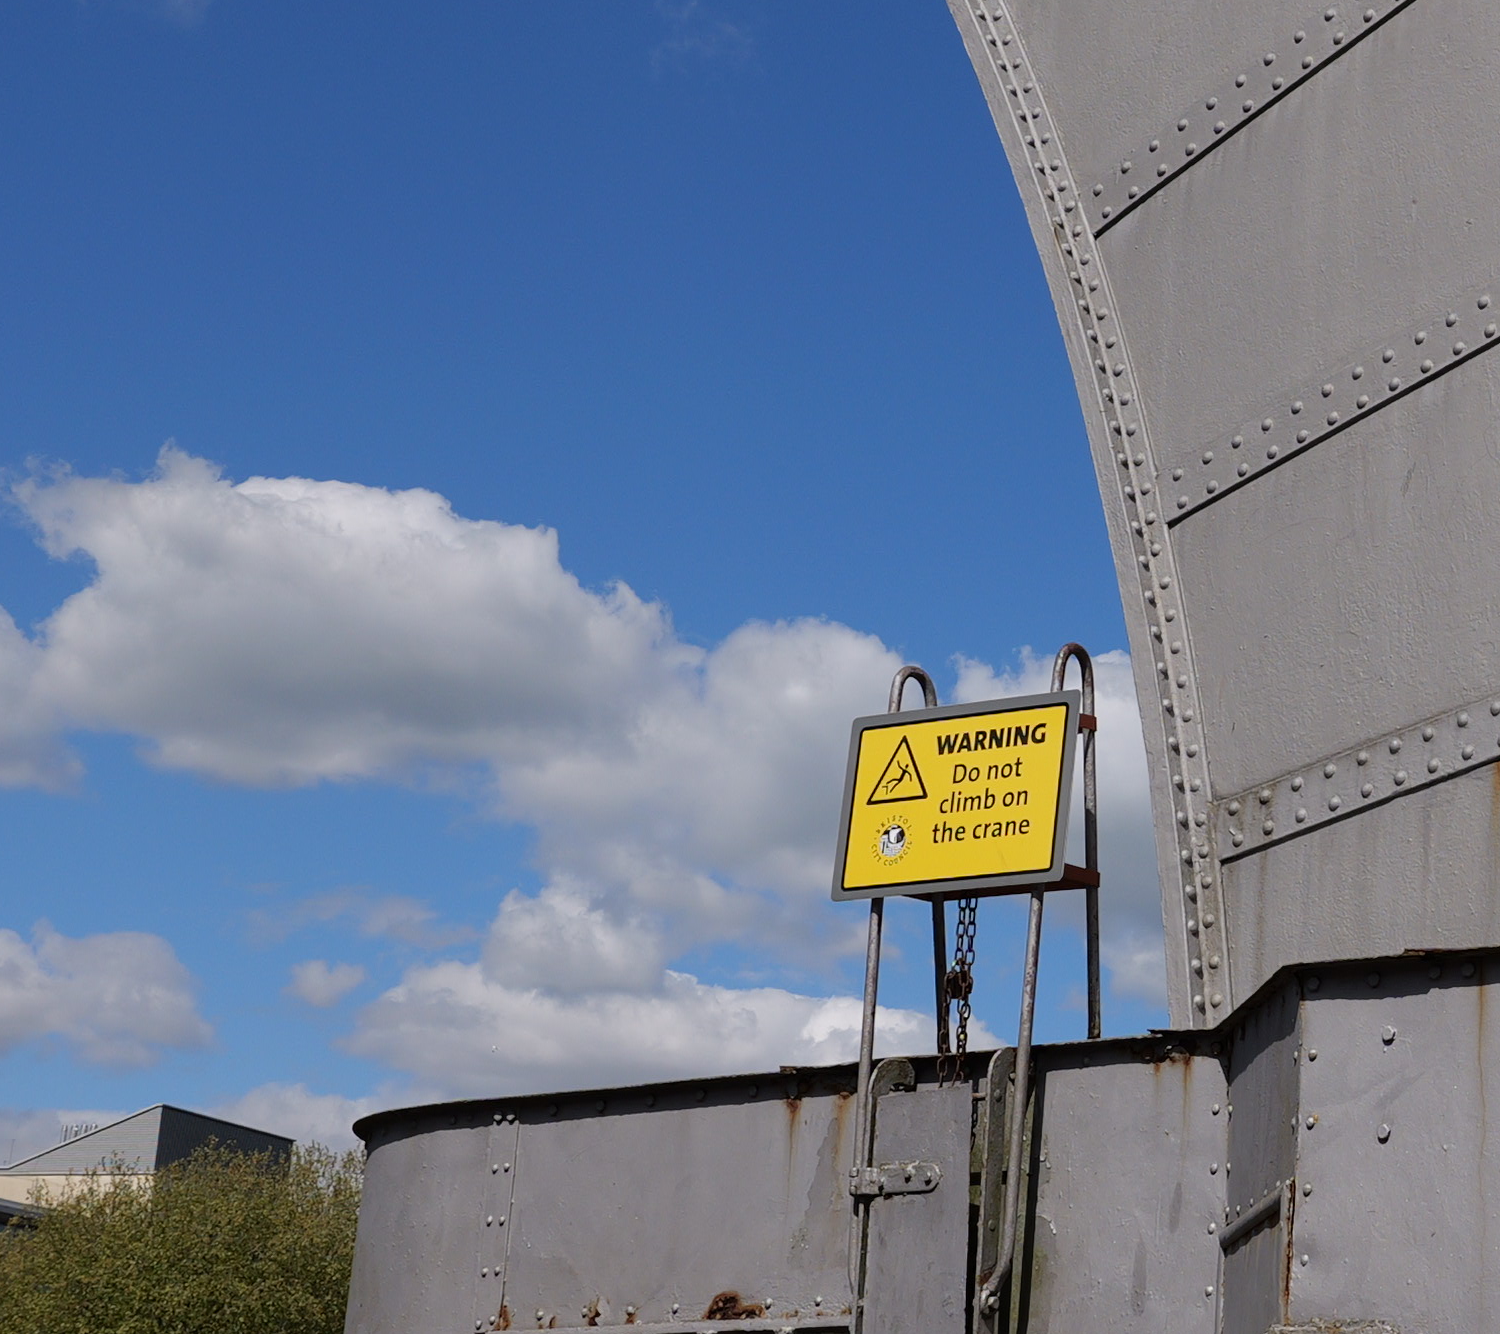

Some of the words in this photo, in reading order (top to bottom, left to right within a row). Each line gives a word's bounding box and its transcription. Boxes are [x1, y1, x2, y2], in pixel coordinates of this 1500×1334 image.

[937, 722, 1047, 755] WARNING
[952, 763, 980, 784] Do
[986, 756, 1023, 780] not
[939, 787, 996, 814] climb
[1002, 789, 1028, 807] on
[932, 820, 966, 844] the
[972, 818, 1030, 839] crane
